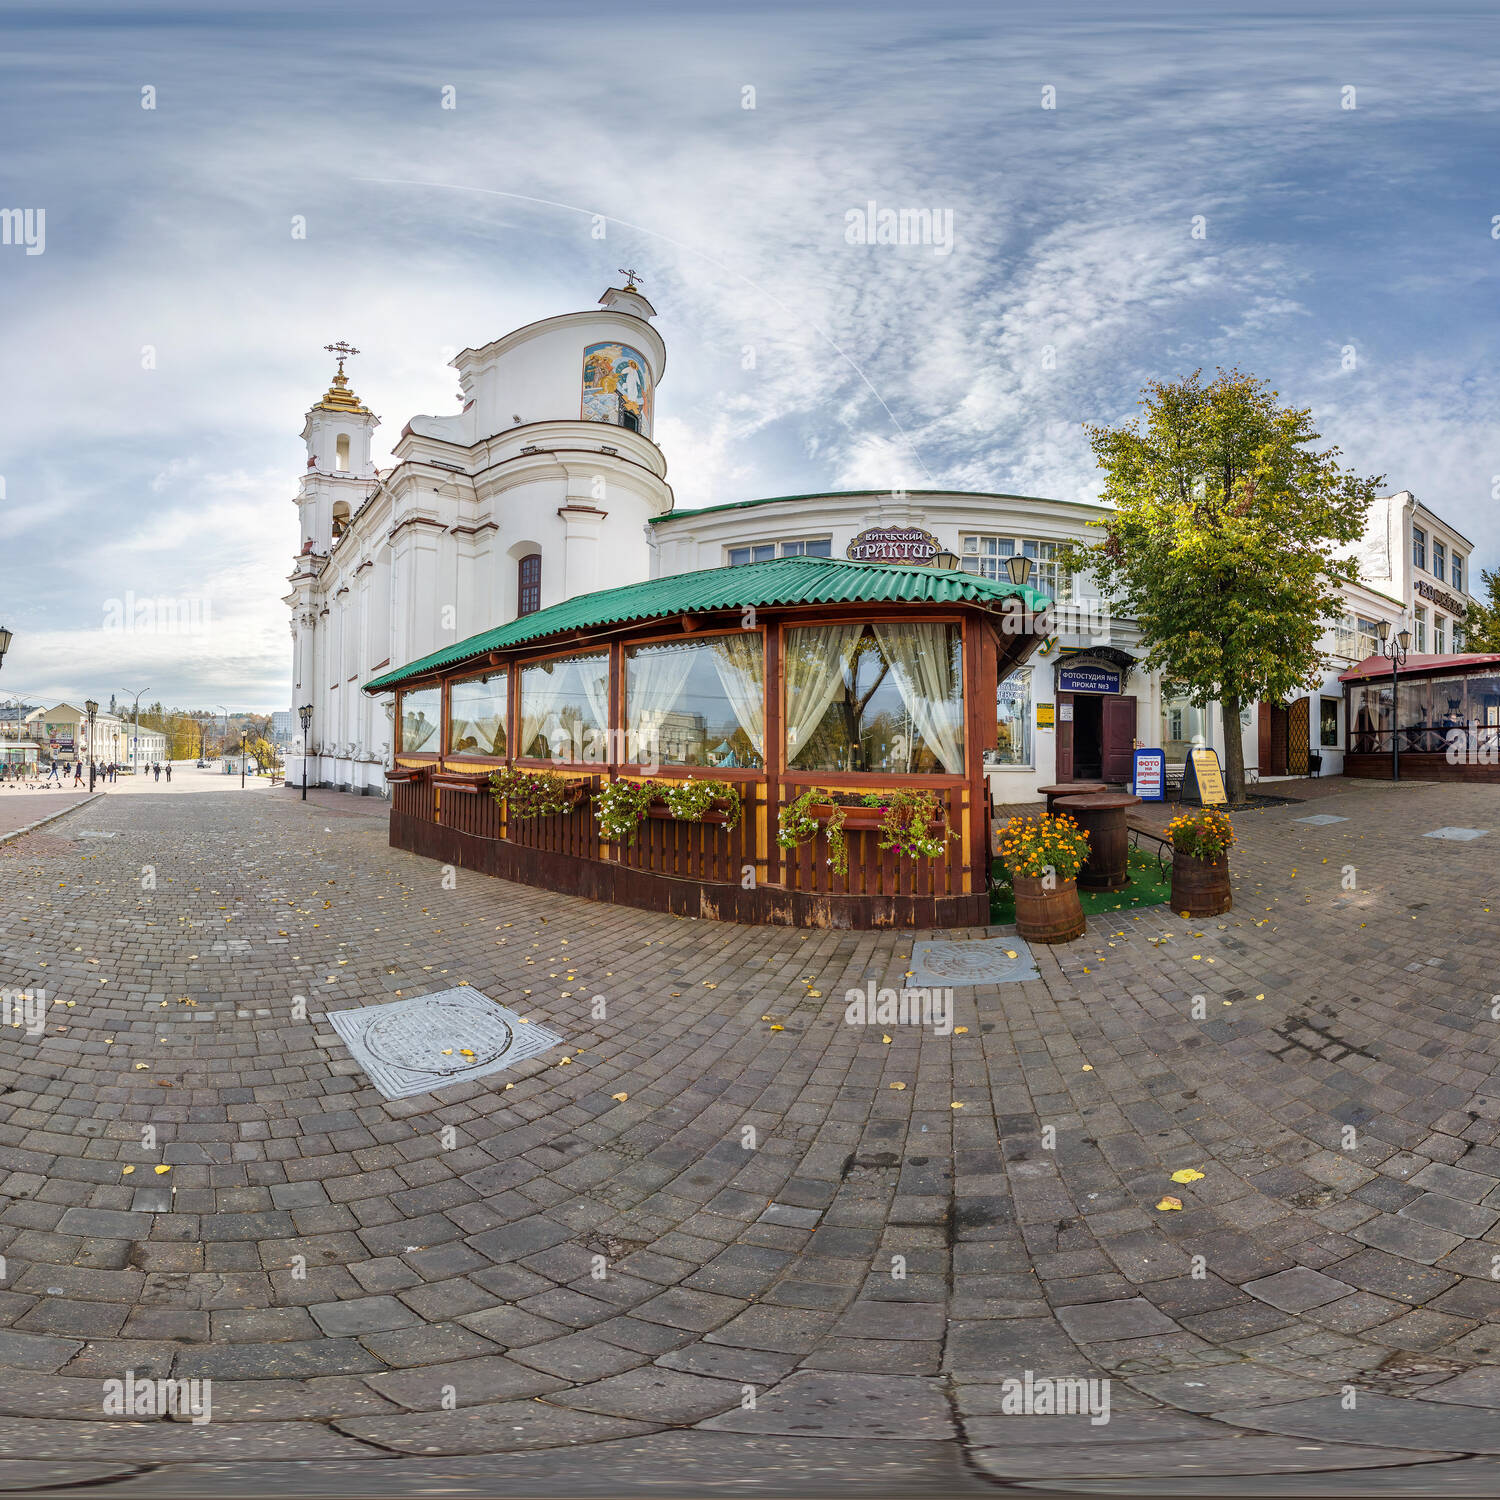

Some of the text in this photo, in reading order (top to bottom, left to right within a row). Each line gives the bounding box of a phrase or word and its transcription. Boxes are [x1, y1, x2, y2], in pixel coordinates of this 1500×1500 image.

[865, 532, 923, 541] ВИТЕБСКИЙ
[853, 542, 936, 559] ТРАКТИР
[1062, 672, 1105, 681] ФОТОСТУДИЯ
[1072, 681, 1096, 689] ПРОКАТ
